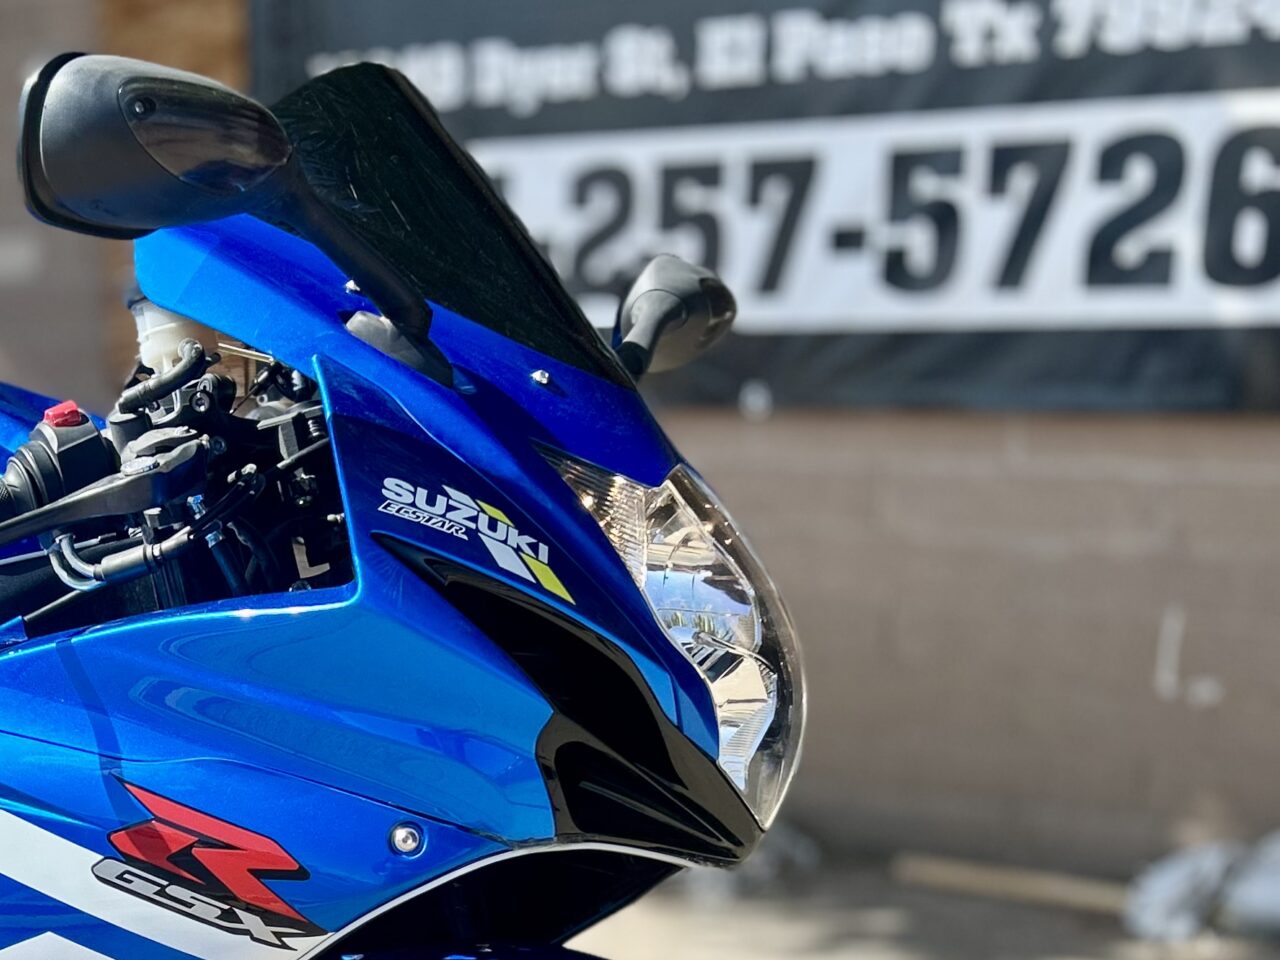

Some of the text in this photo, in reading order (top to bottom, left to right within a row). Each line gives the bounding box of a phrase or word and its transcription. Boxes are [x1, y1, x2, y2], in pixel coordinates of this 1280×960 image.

[772, 8, 936, 82] Paso
[492, 127, 1280, 294] 257-5726
[378, 499, 469, 541] ECSTAR
[381, 477, 549, 565] SUZUKI
[92, 857, 308, 948] GSX
